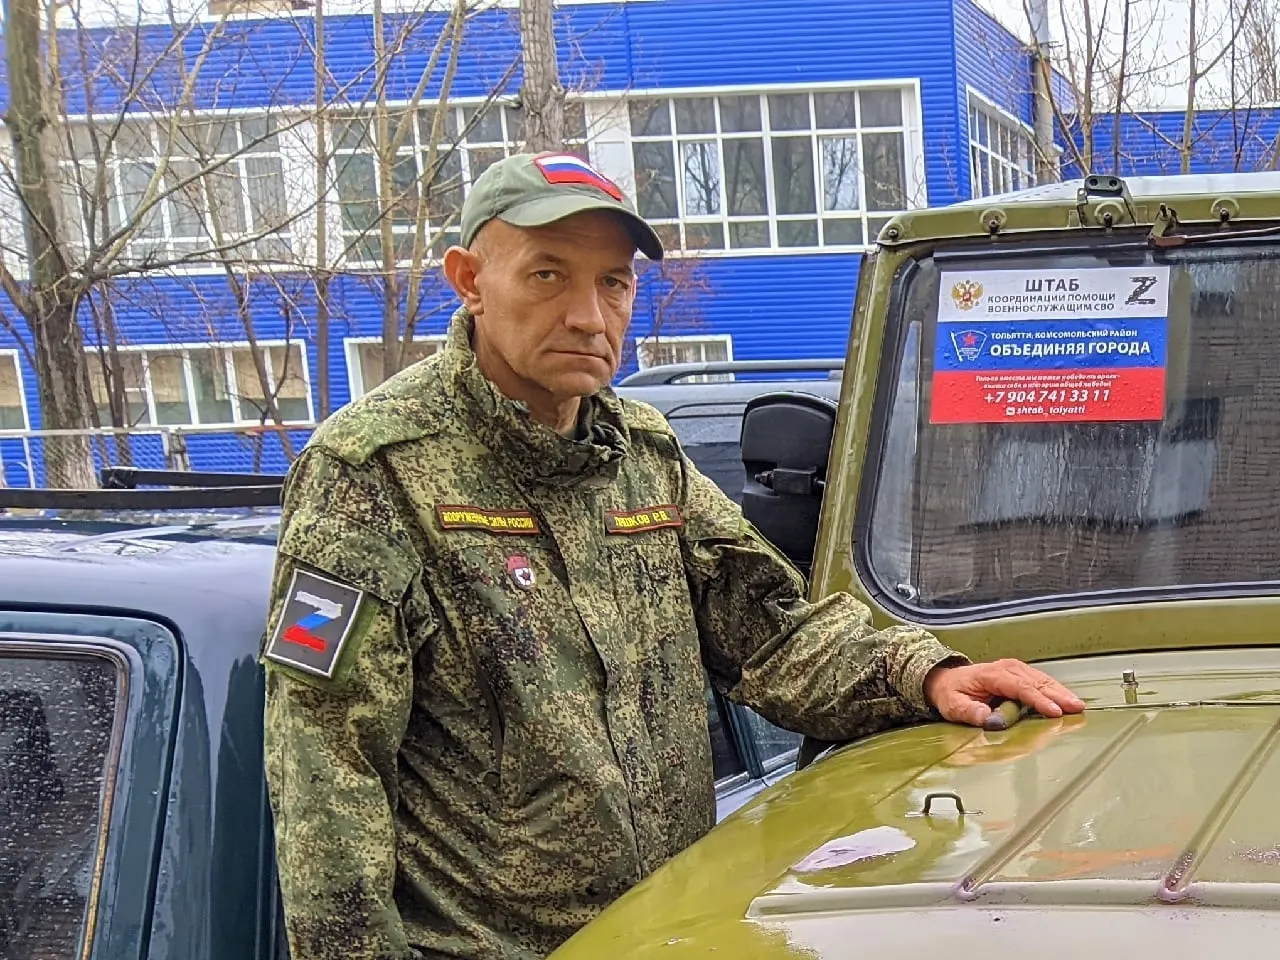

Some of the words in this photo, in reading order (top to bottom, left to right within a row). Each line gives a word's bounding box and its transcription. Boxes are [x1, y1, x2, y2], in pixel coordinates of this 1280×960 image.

[1025, 279, 1079, 292] ШТАБ
[988, 294, 1065, 304] КООРДИНАЦИИ
[1068, 293, 1116, 302] ПОМОЩИ
[988, 303, 1092, 313] ВОЕННОСЛУЖАЩИМ
[1094, 302, 1115, 311] СВО
[991, 332, 1034, 340] ТОЛЬЯТТИ,
[1035, 330, 1109, 339] КОМСОМОЛЬСКИЙ
[1110, 329, 1138, 337] РАЙОН
[990, 342, 1085, 358] ОБЪЕДИНЯЯ
[1088, 341, 1151, 356] ГОРОДА
[984, 391, 1005, 403] +7
[1007, 391, 1036, 403] 904
[1038, 390, 1066, 402] 741
[1069, 389, 1088, 402] 33
[1093, 389, 1110, 402] 11
